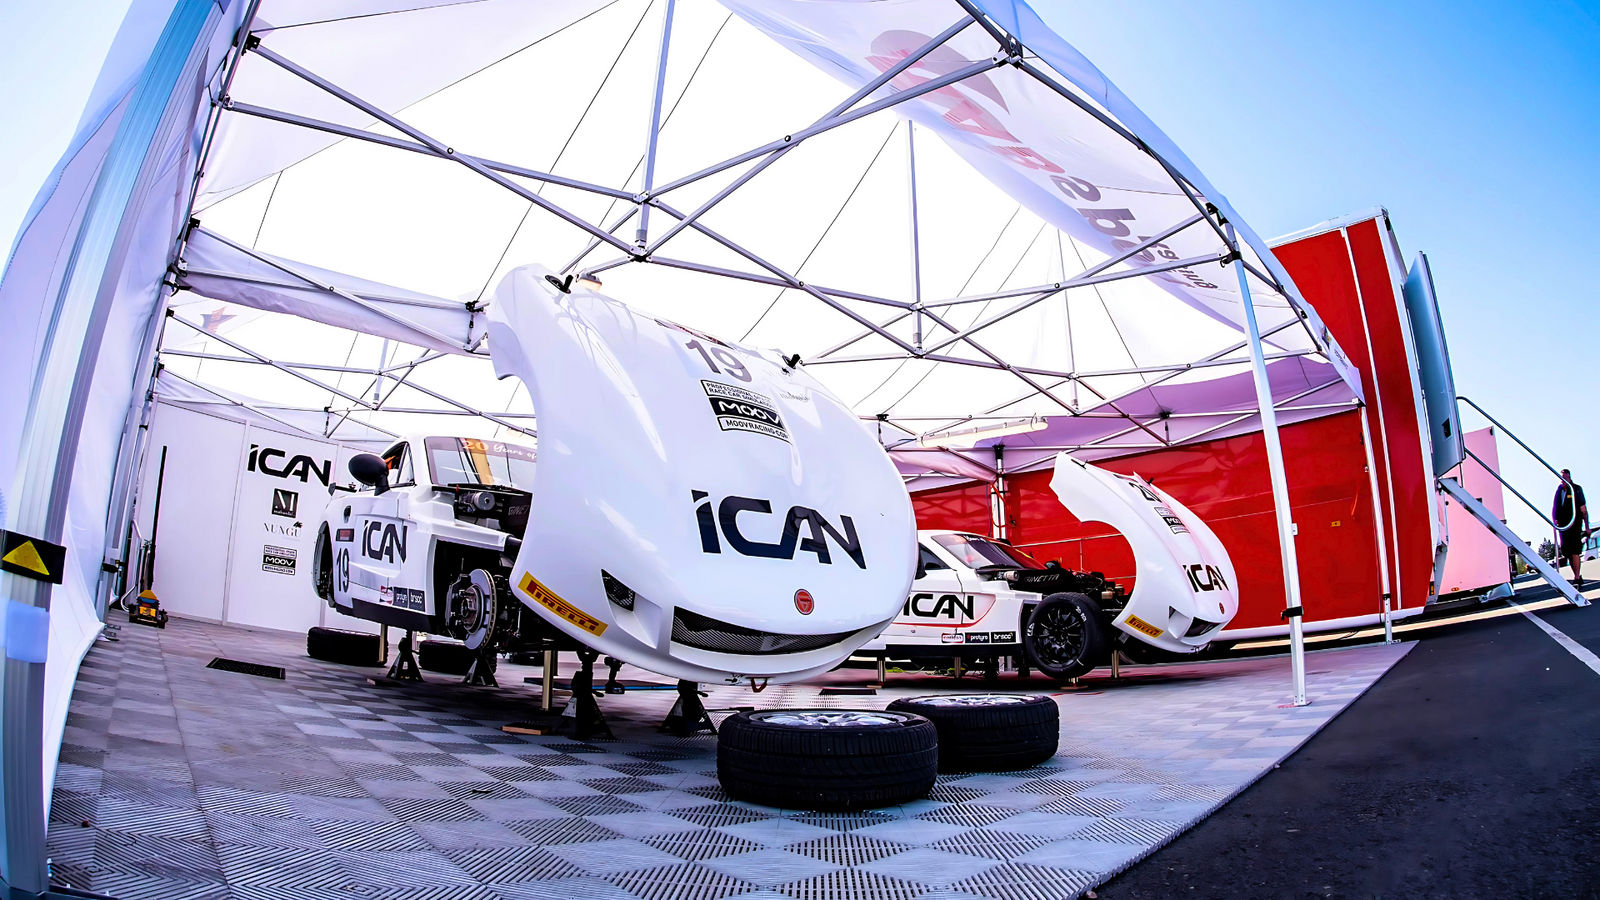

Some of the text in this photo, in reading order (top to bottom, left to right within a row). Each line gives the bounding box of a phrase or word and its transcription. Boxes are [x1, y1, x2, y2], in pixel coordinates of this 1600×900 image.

[685, 339, 753, 383] 19
[718, 401, 780, 424] MOOV
[265, 556, 294, 567] MOOV
[336, 547, 350, 593] 19
[526, 579, 600, 632] PIRELLI
[1128, 617, 1161, 636] PIRELLI
